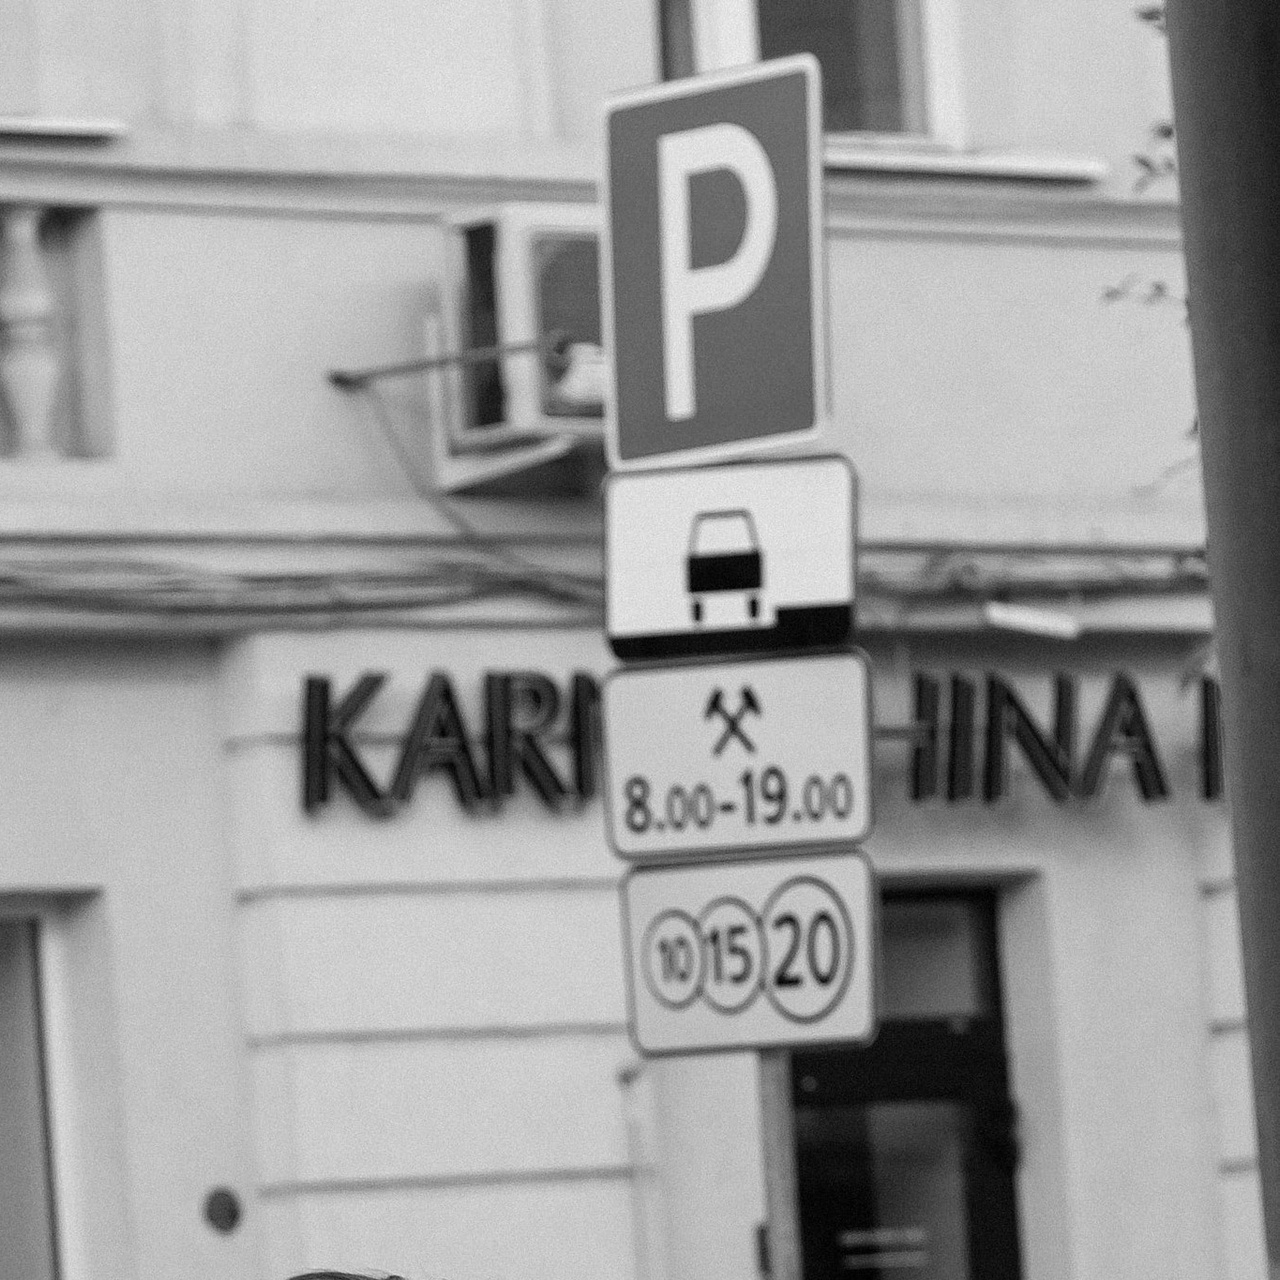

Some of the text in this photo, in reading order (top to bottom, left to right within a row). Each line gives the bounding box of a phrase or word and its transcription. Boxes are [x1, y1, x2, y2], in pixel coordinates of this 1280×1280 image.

[658, 123, 778, 422] P
[624, 765, 854, 834] 8.00-19.00
[658, 911, 840, 987] 10 15 20
